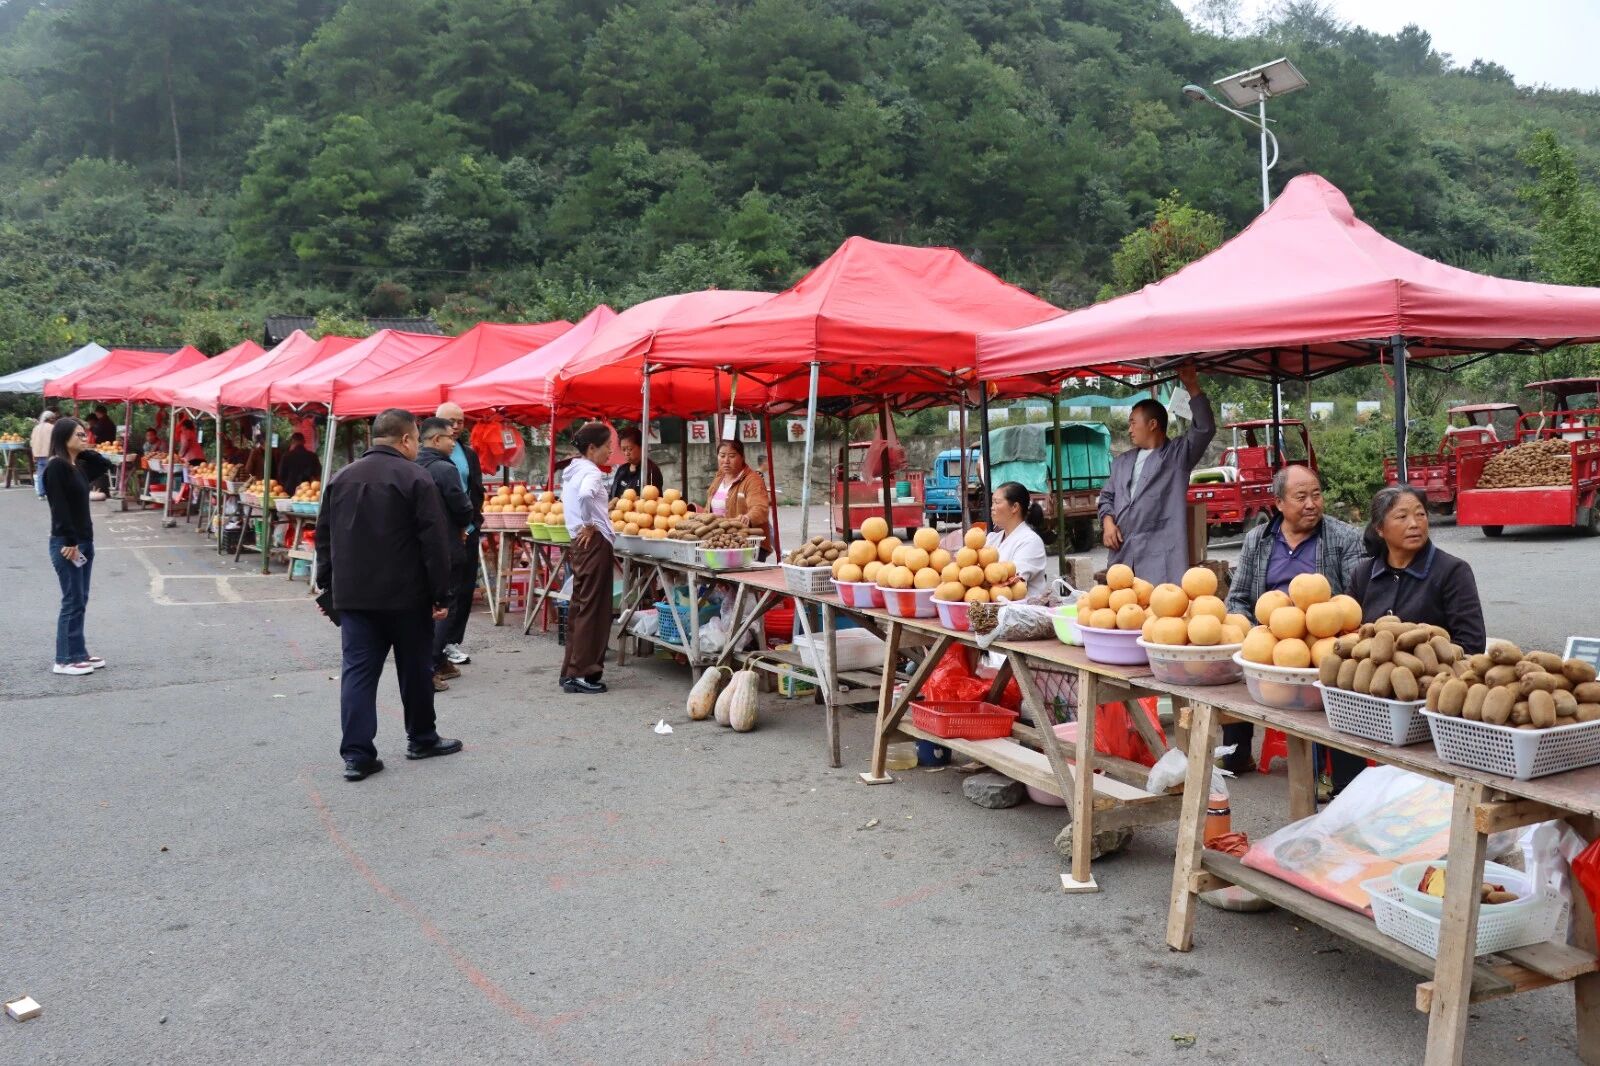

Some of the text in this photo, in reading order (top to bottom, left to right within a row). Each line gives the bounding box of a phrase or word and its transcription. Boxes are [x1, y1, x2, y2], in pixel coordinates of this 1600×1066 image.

[691, 424, 707, 440] 民
[743, 423, 757, 439] 战
[791, 423, 805, 438] 争
